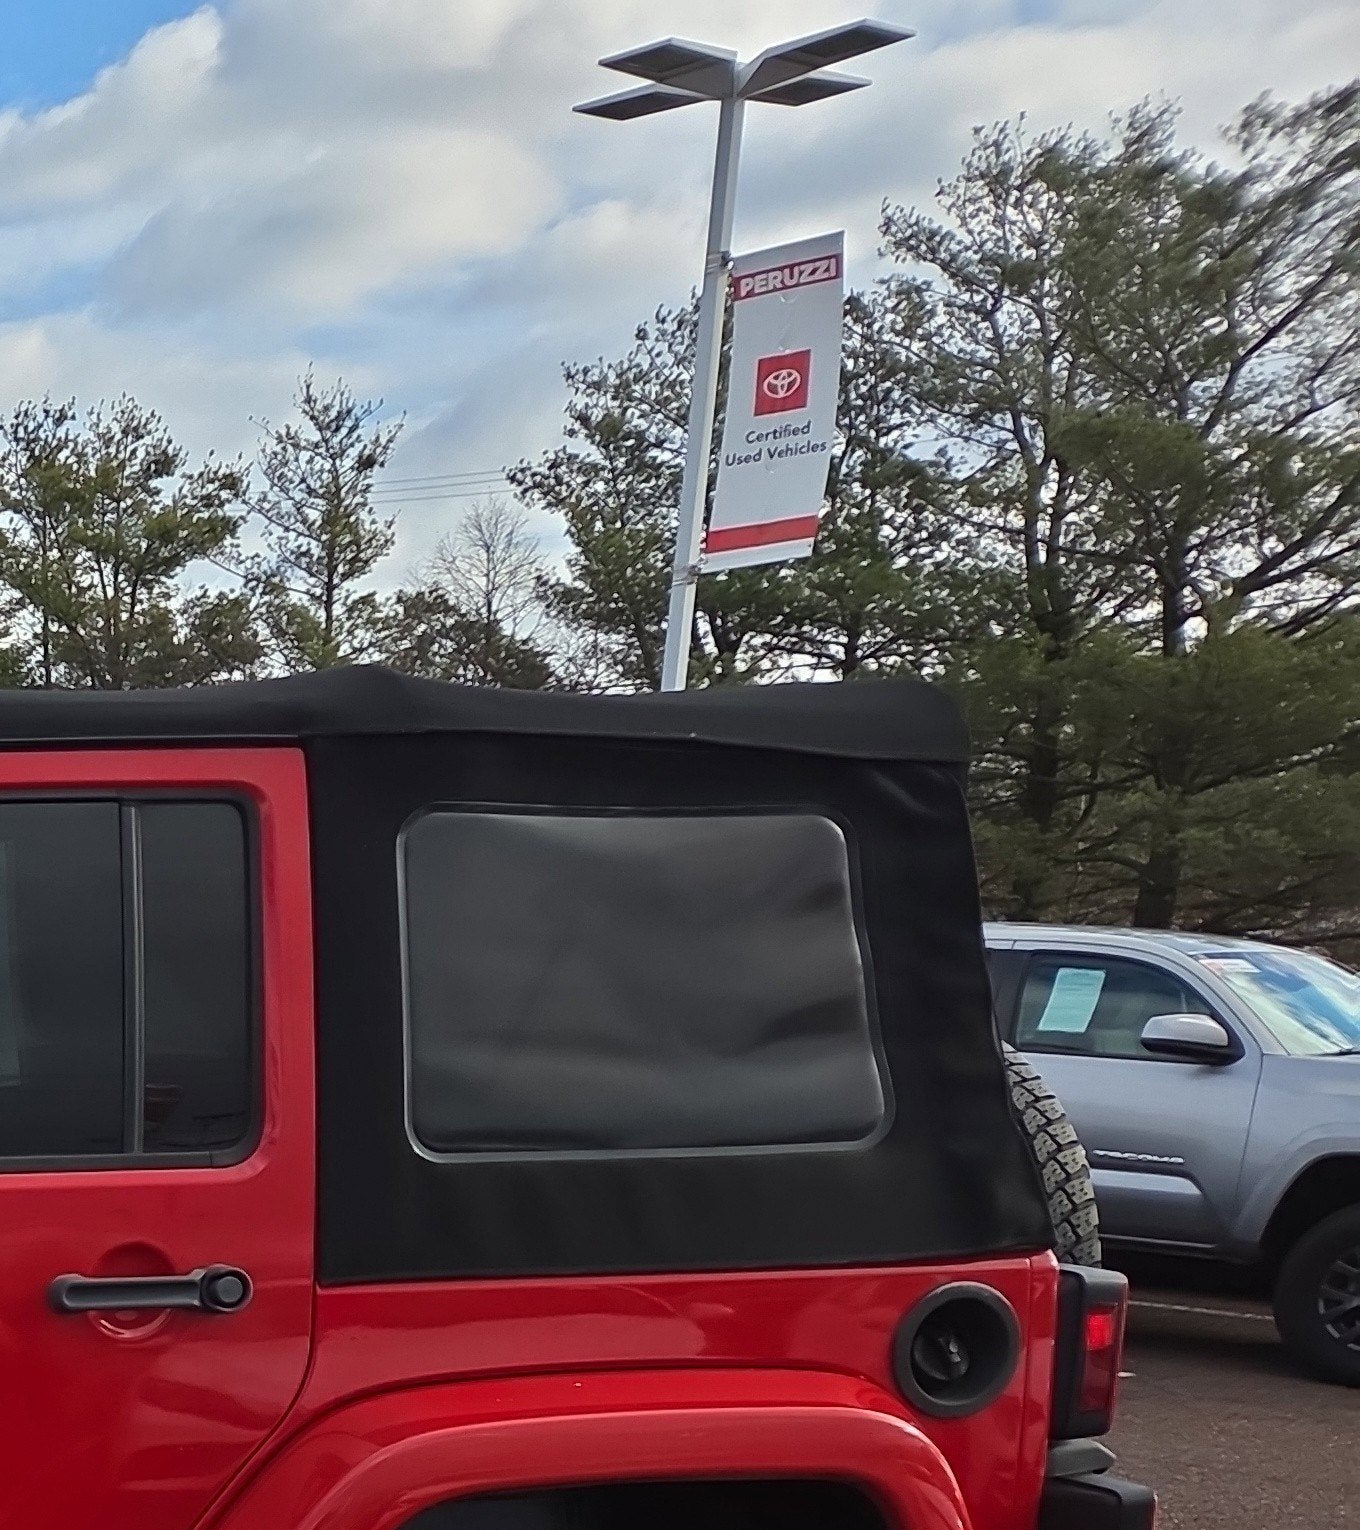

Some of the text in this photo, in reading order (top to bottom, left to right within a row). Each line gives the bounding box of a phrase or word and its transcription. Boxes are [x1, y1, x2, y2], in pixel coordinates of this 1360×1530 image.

[740, 257, 838, 297] PERUZZI
[745, 419, 812, 444] Certified
[725, 440, 827, 467] Used Vehicles
